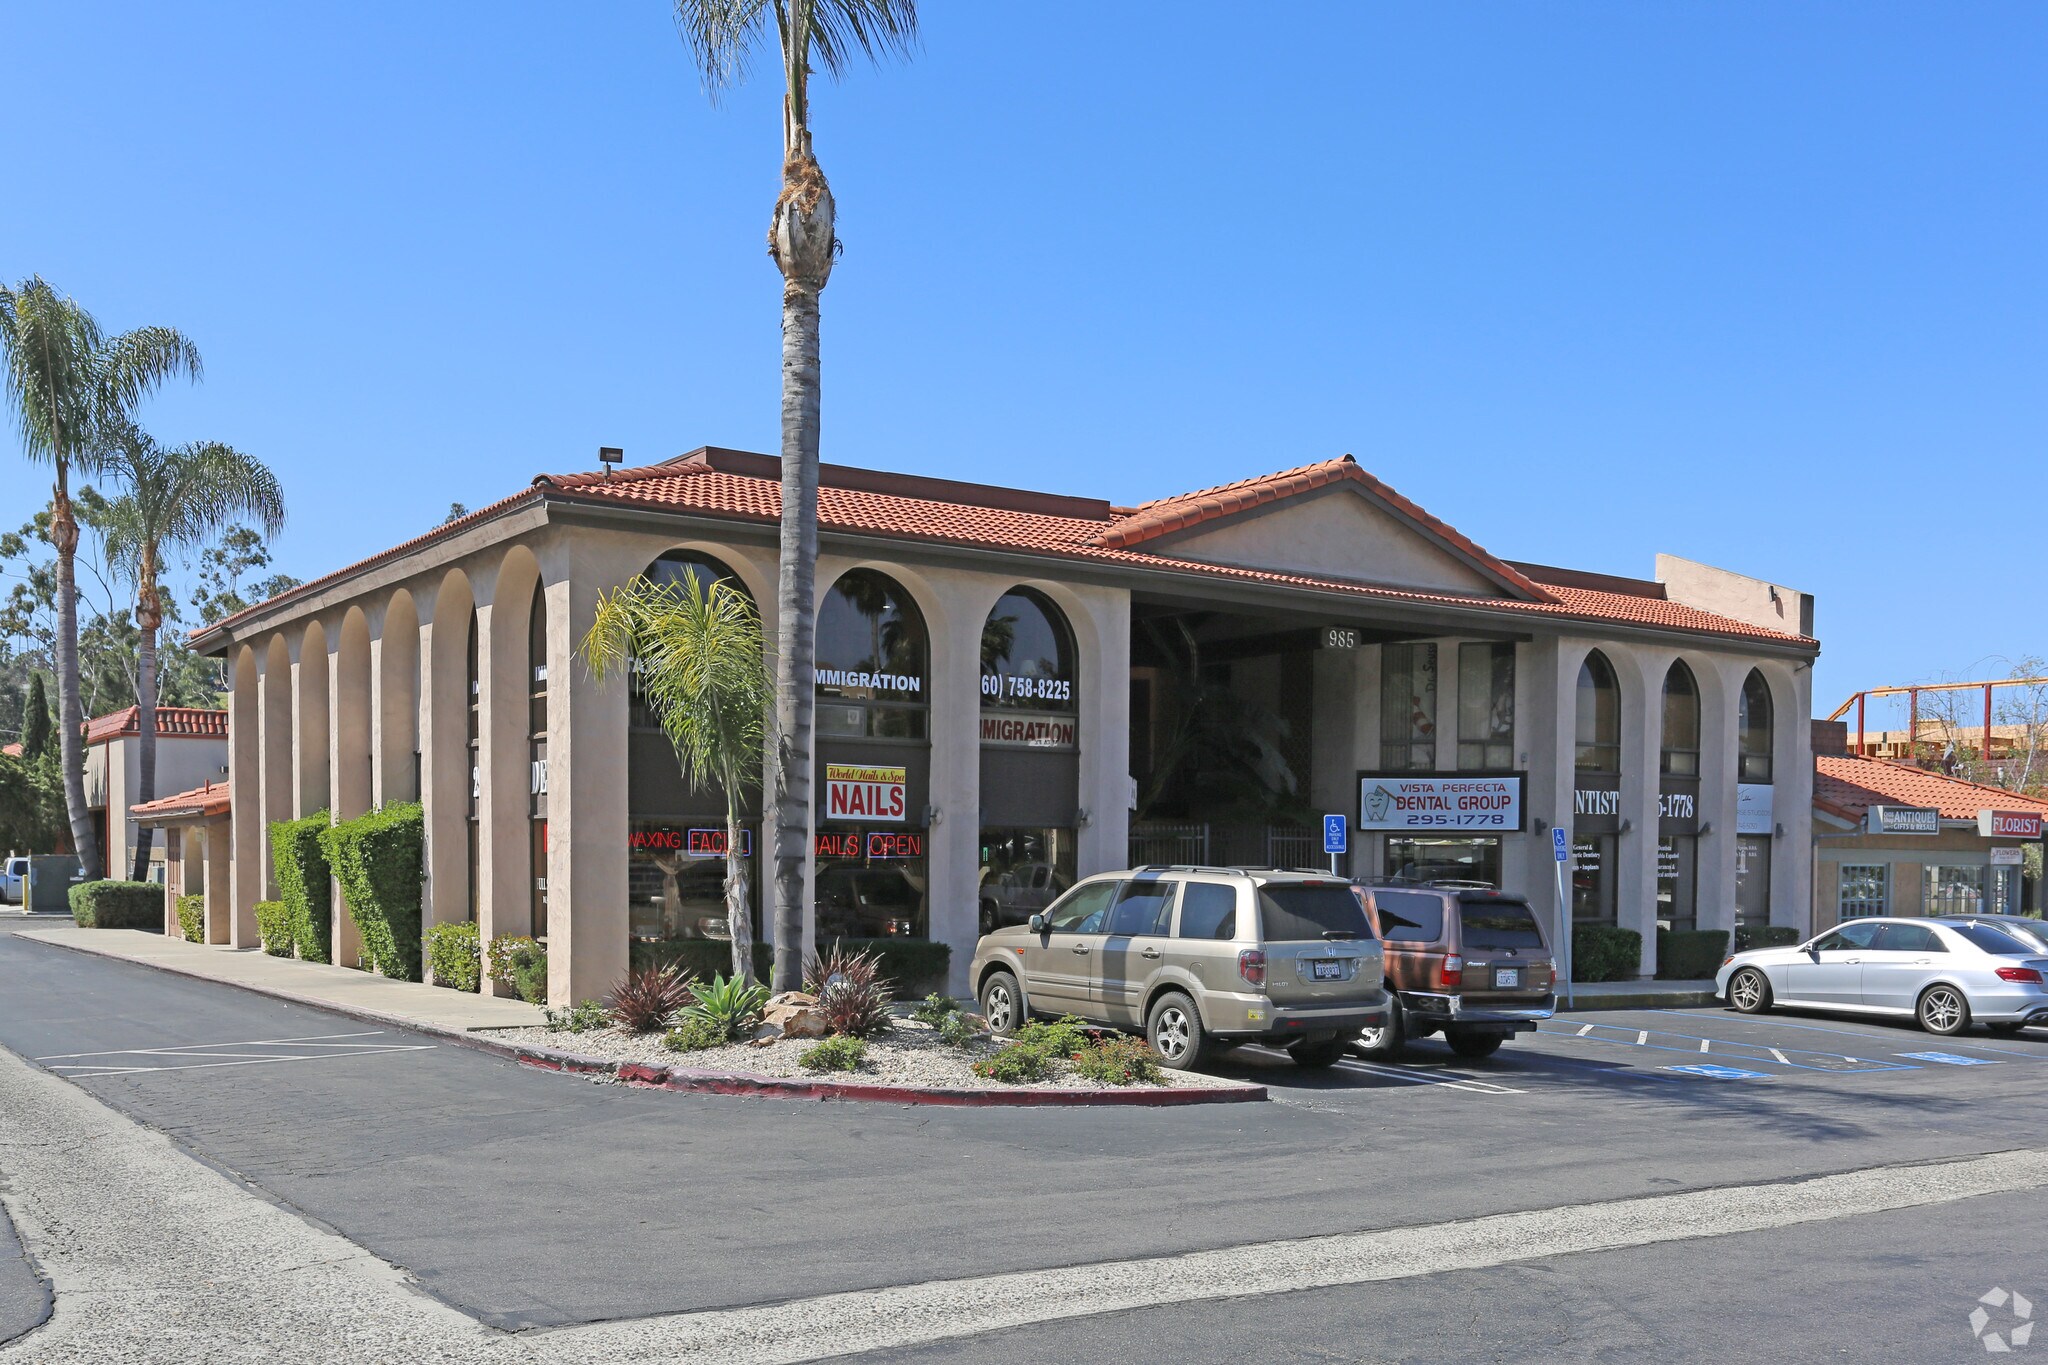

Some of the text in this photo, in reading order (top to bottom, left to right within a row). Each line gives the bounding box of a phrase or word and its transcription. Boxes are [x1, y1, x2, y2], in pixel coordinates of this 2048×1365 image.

[1329, 629, 1354, 649] 985
[1008, 676, 1070, 701] 758-8225
[829, 768, 905, 784] World Nails & Spa
[1400, 783, 1506, 793] VISTA PERFECTA
[831, 784, 904, 817] NAILS
[1396, 795, 1511, 810] DENTAL GROUP
[1407, 814, 1504, 825] 295-1778
[1894, 811, 1936, 824] ANTIQUES
[1993, 818, 2039, 833] FLORIST
[627, 832, 681, 849] WAXING
[869, 835, 920, 855] OPEN
